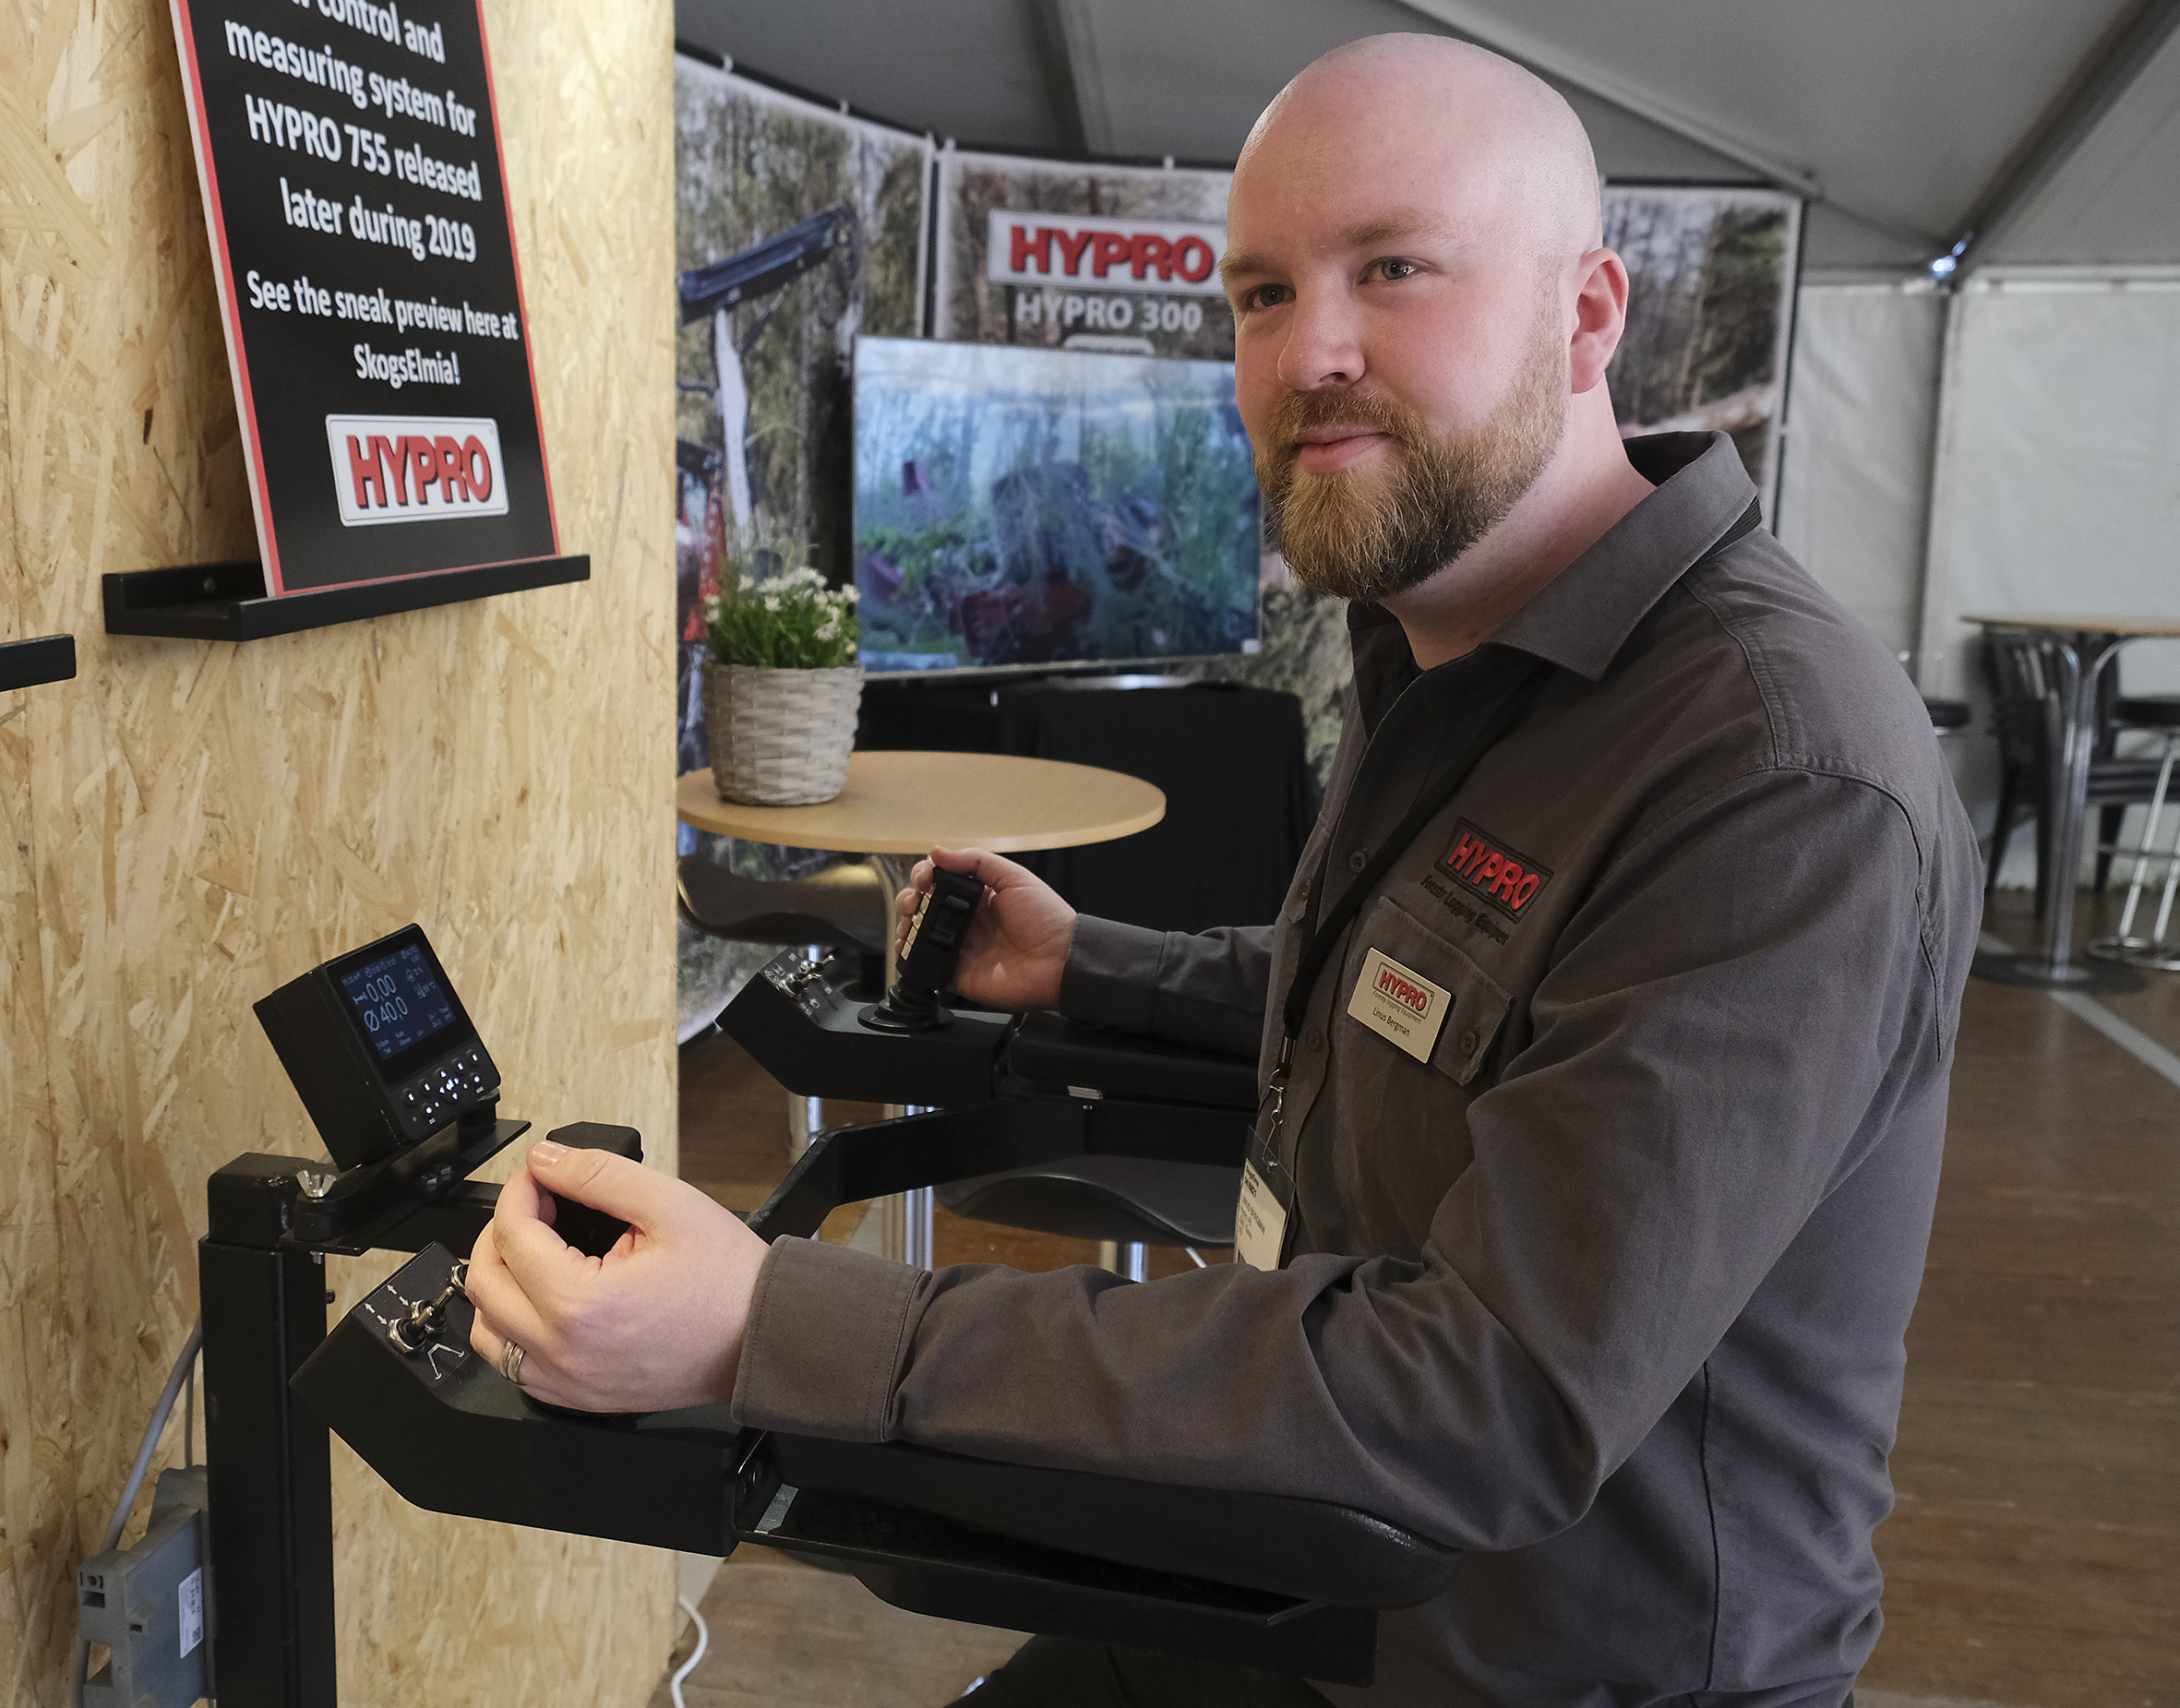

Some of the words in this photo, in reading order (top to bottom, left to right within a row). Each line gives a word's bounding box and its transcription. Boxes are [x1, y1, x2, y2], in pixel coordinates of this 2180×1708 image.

[317, 0, 401, 45] control
[404, 18, 446, 64] and
[224, 19, 368, 110] measuring
[368, 69, 447, 127] system
[447, 90, 477, 137] for
[245, 93, 342, 162] HYPRO
[344, 123, 392, 177] 755
[394, 142, 483, 202] released
[280, 176, 343, 235] later
[349, 195, 426, 262] during
[425, 214, 478, 263] 2019
[1010, 224, 1215, 283] HYPRO
[246, 269, 293, 313] See
[293, 275, 333, 317] the
[335, 287, 395, 325] sneak
[395, 296, 462, 334] preview
[463, 301, 501, 339] here
[501, 311, 520, 341] at
[1015, 292, 1134, 330] HYPRO
[1139, 300, 1204, 333] 300
[353, 343, 461, 388] SkogsElmia!
[345, 435, 494, 510] HYPRO
[1446, 832, 1540, 911] HYPRO
[365, 973, 397, 1003] 0,00
[380, 996, 408, 1023] 40,0
[1378, 969, 1428, 1012] HYPRO
[1372, 1007, 1386, 1022] Linus
[1386, 1016, 1410, 1037] Bergman
